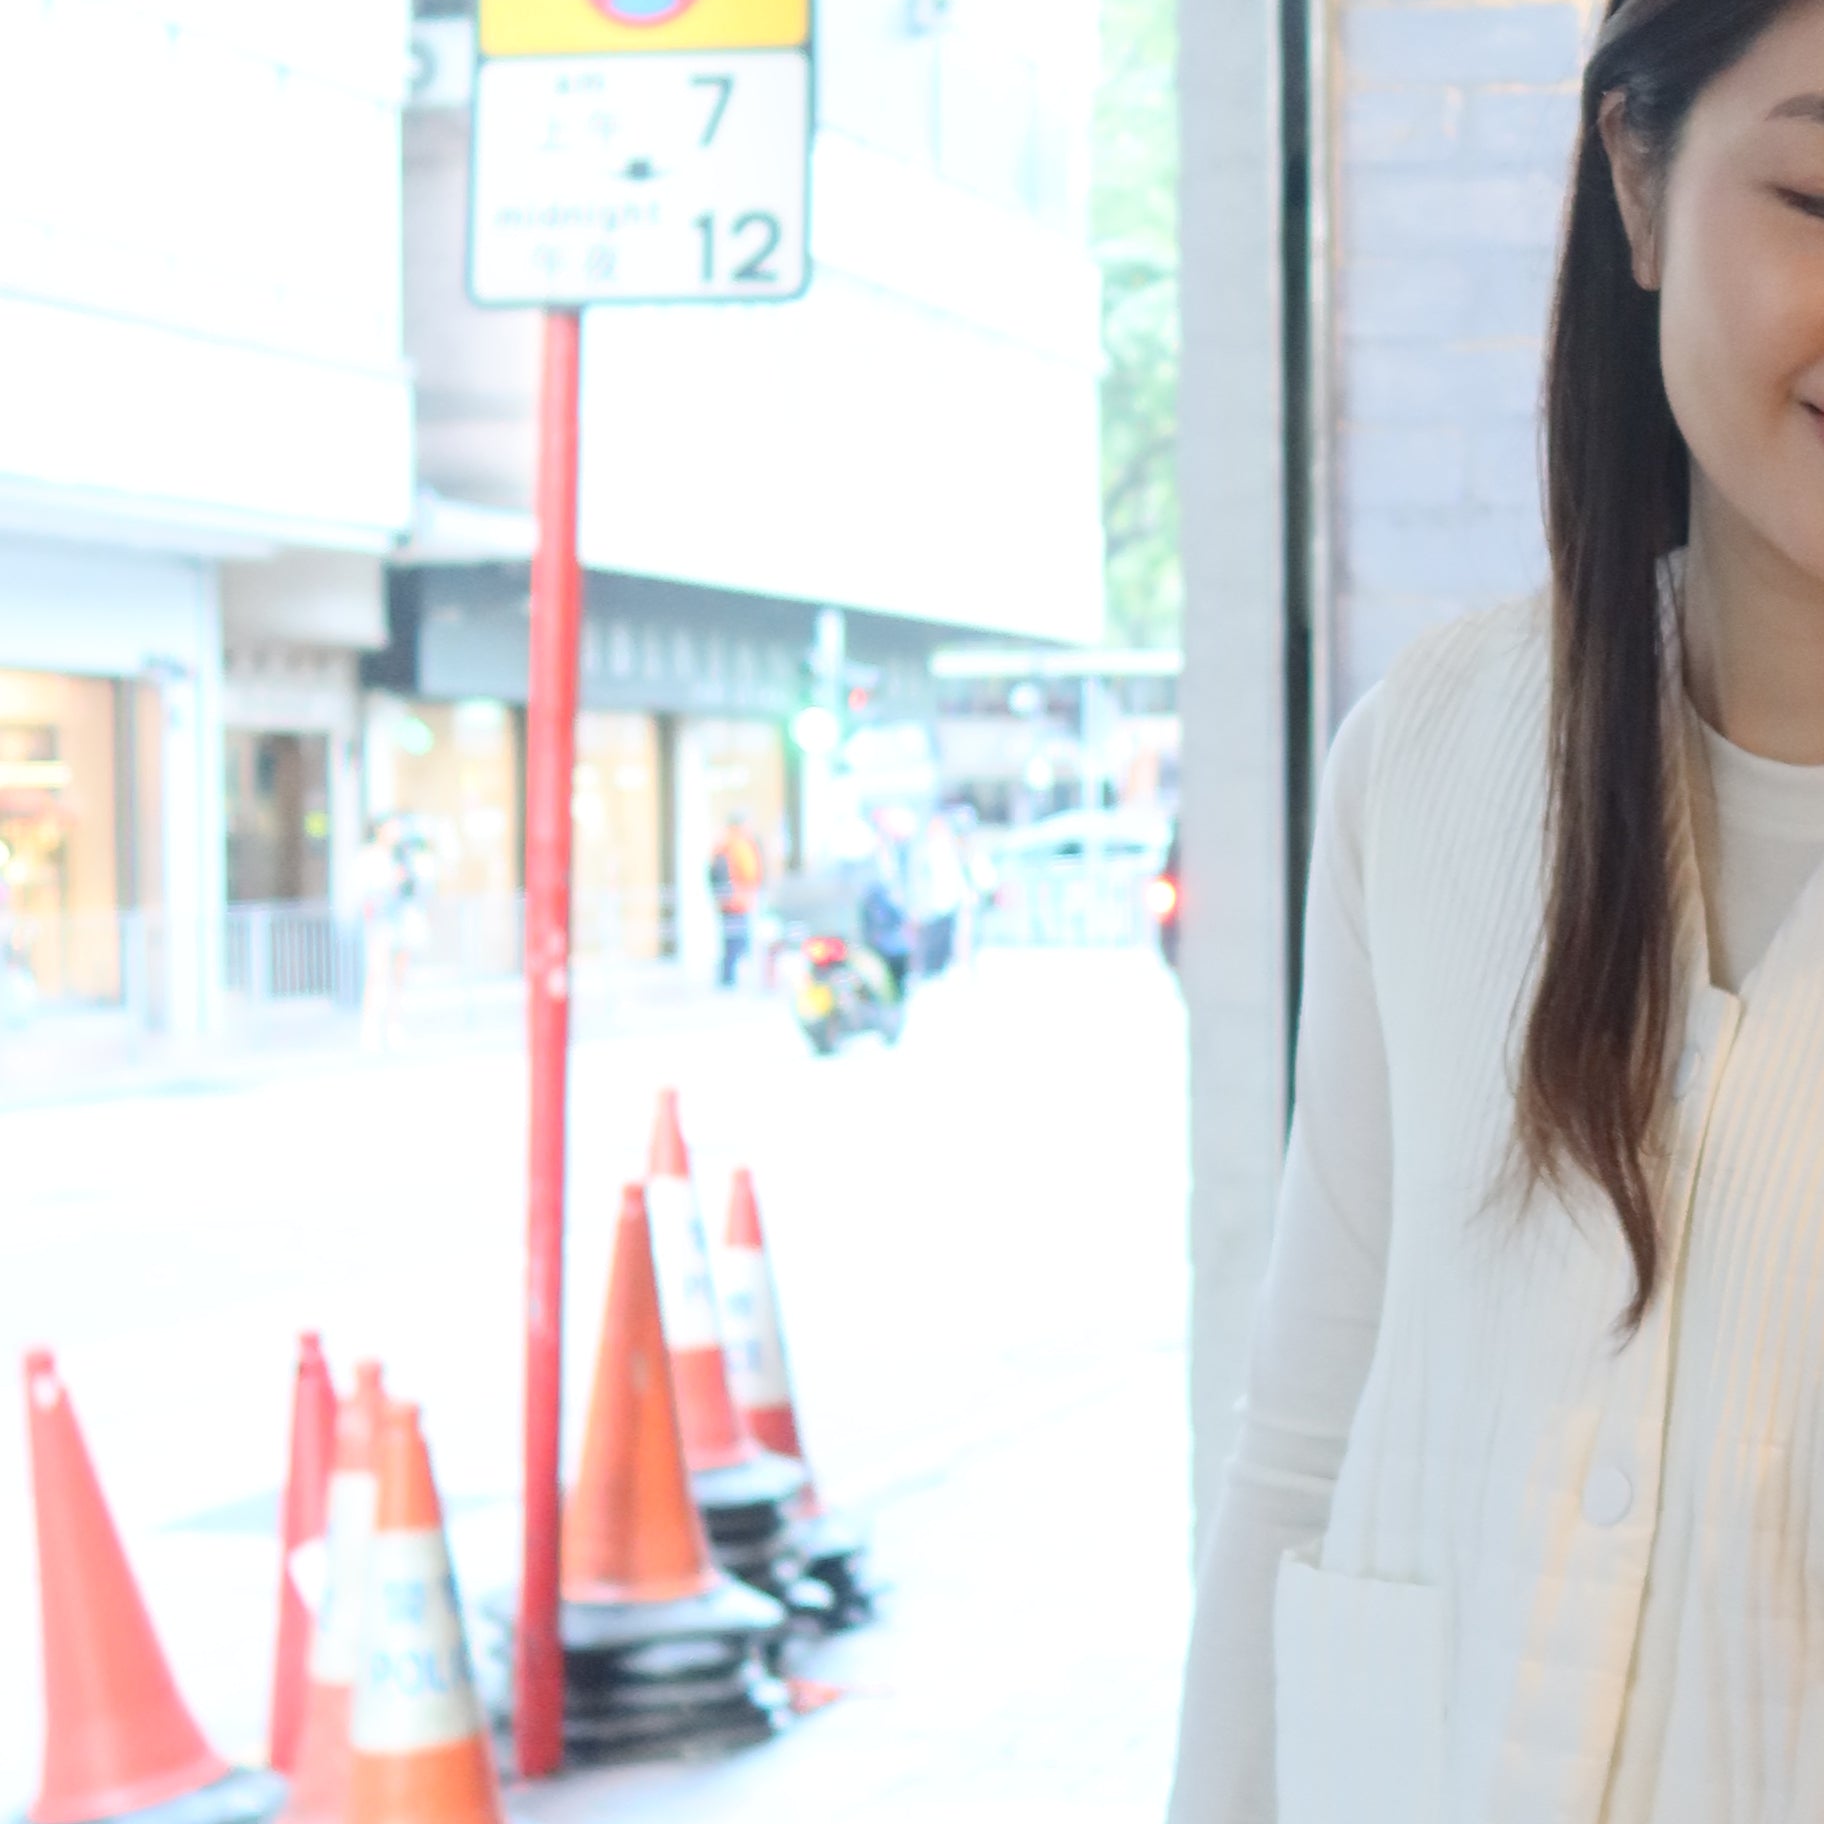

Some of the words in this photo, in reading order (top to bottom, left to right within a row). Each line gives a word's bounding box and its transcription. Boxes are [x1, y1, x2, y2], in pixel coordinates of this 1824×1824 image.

[688, 73, 738, 150] 7
[493, 200, 663, 234] midnight
[690, 208, 783, 284] 12
